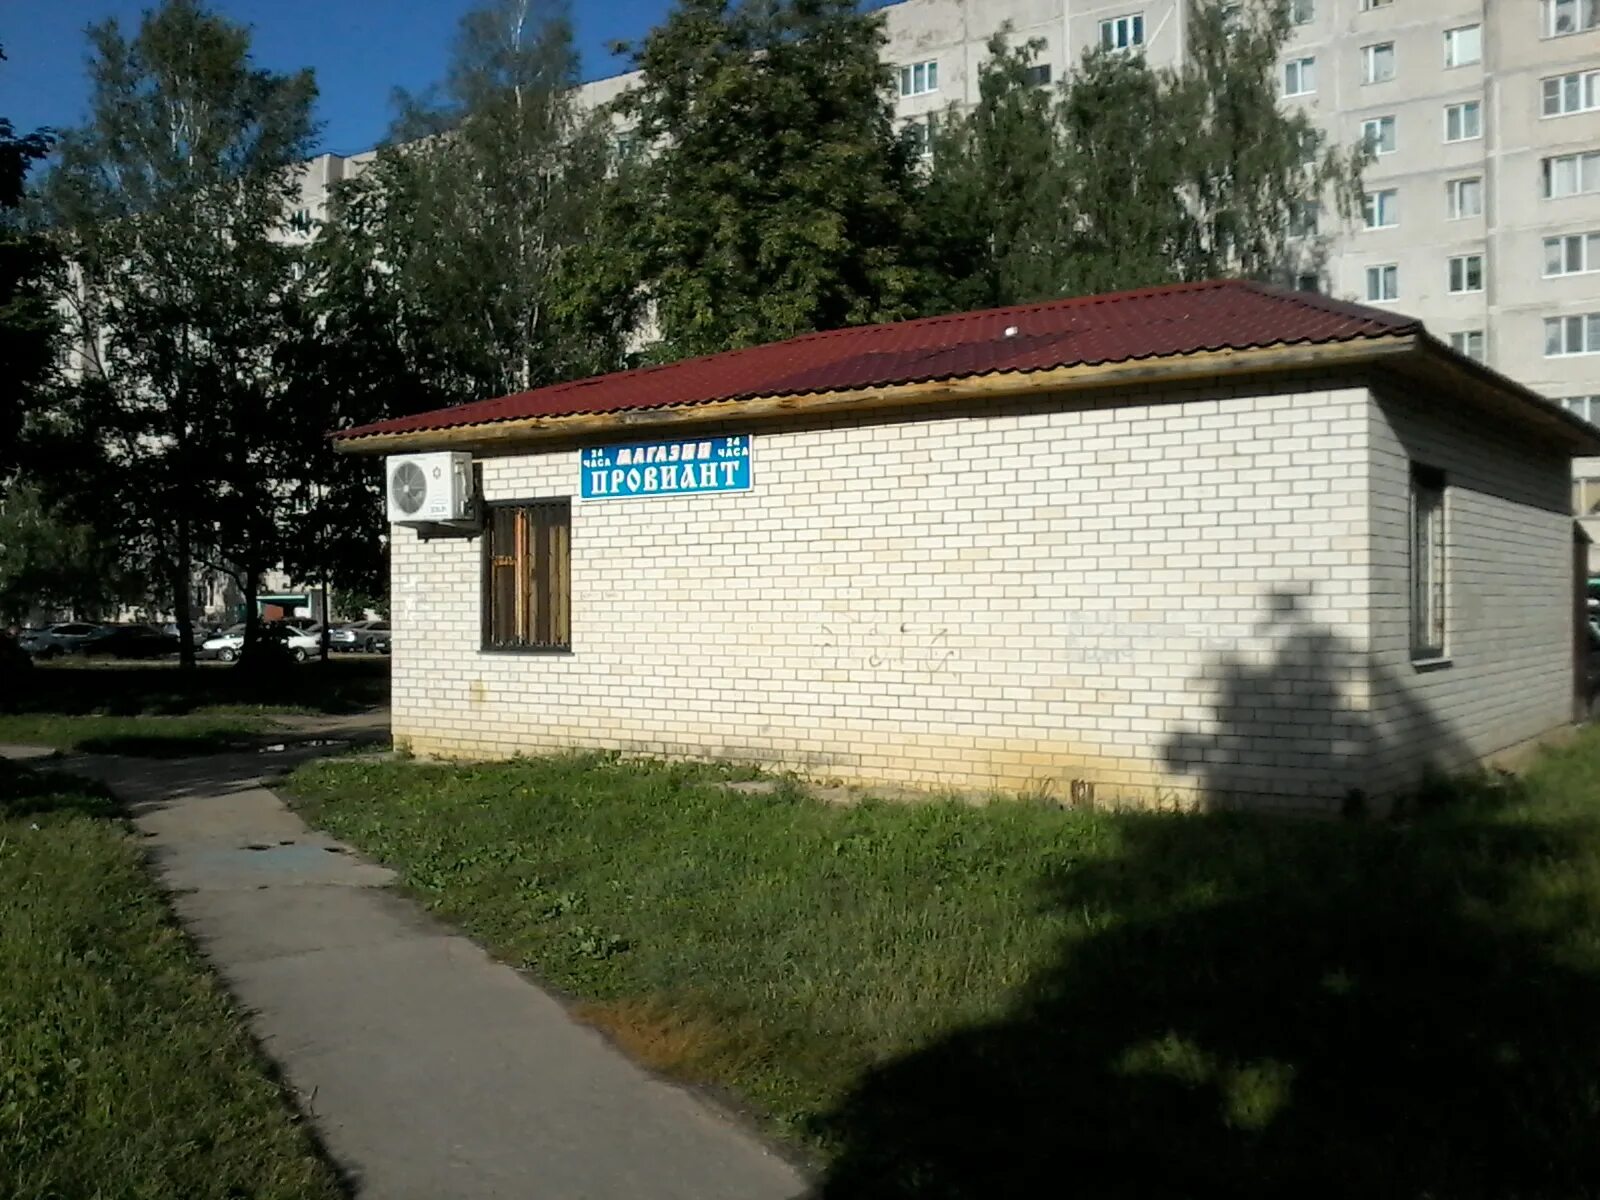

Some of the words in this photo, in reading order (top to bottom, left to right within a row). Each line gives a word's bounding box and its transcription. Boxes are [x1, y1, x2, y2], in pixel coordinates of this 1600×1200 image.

[726, 437, 740, 447] 24
[591, 449, 603, 458] 24
[616, 442, 712, 465] МАГАЗИН
[717, 447, 749, 458] ЧАСА
[583, 458, 611, 468] ЧАСА
[591, 461, 740, 495] ПРОВИАНТ
